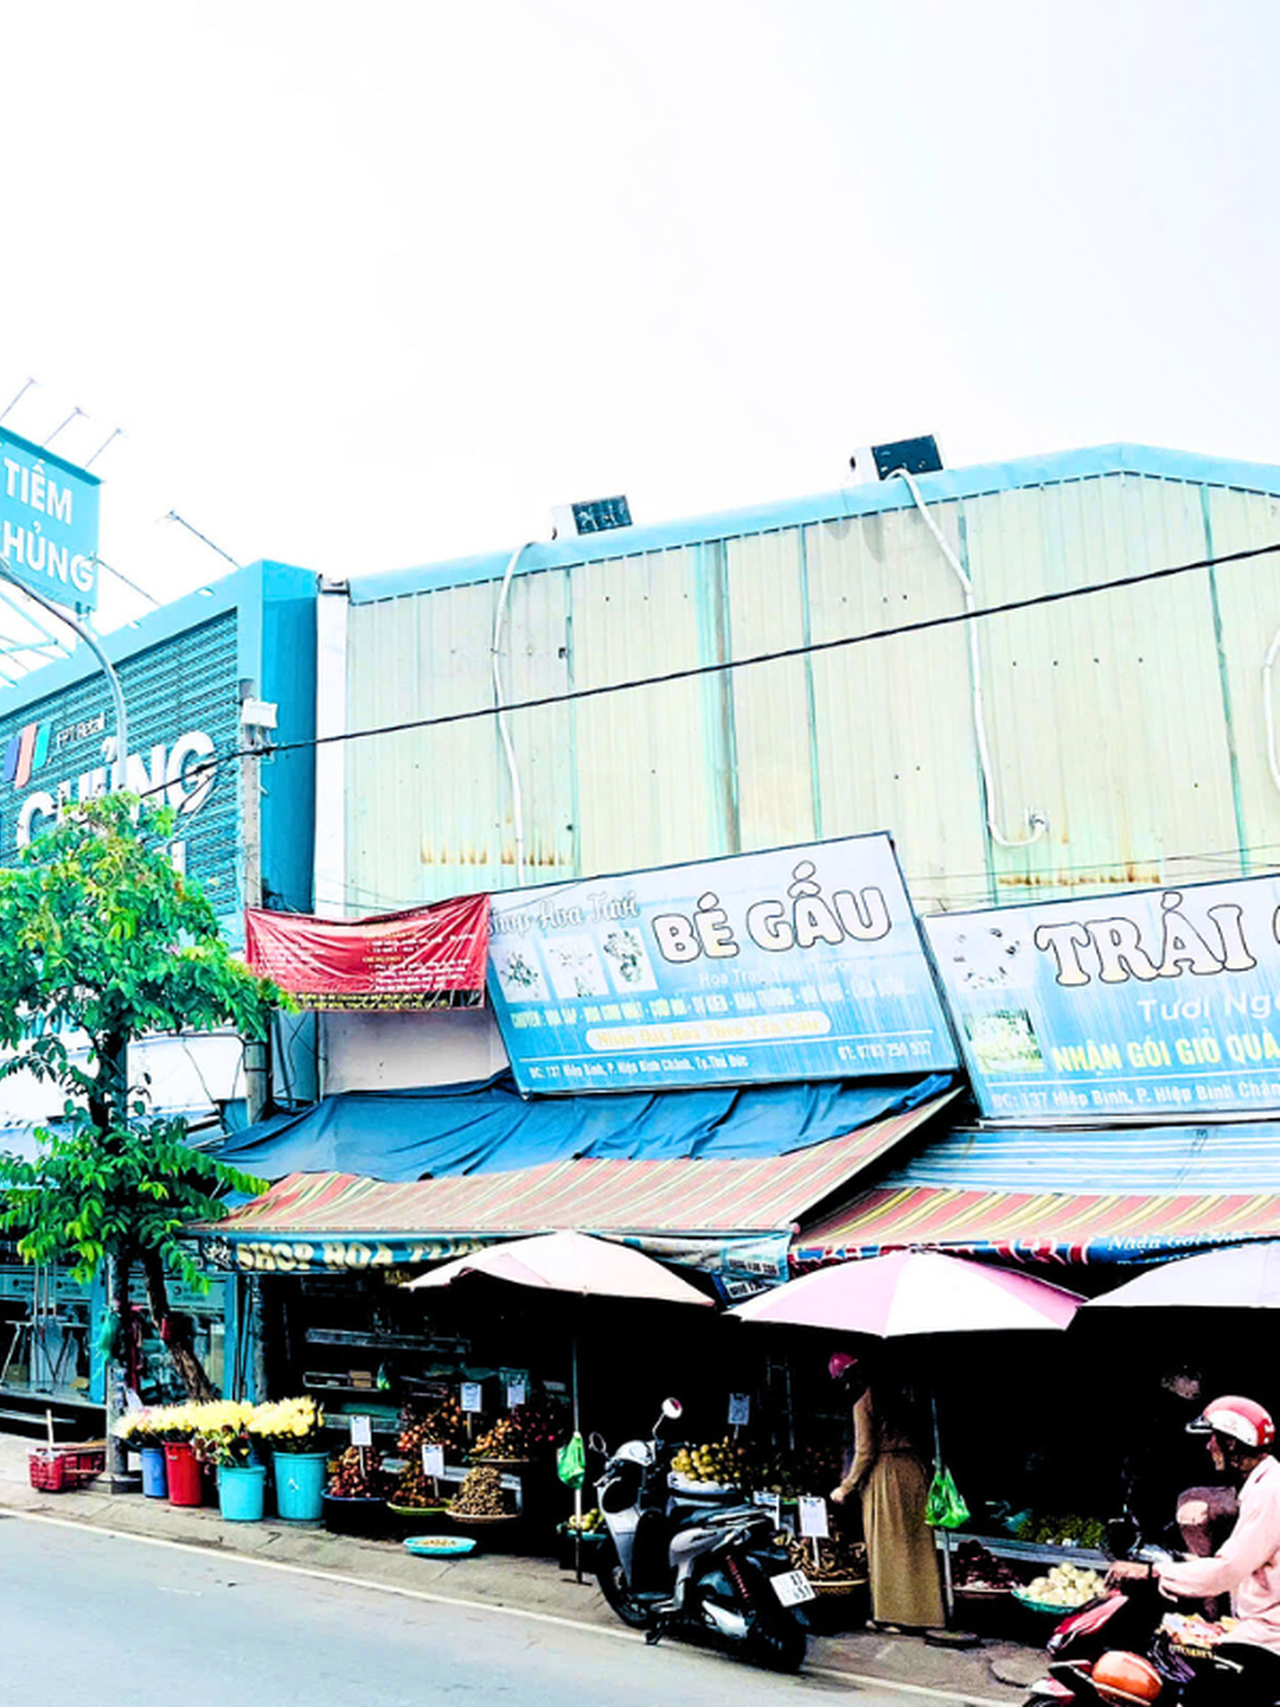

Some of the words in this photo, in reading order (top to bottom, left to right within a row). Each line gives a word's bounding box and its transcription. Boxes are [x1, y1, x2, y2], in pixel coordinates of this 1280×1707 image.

[4, 457, 72, 525] TIÊM
[652, 892, 740, 964] BÉ
[746, 860, 892, 952] GẤU
[1034, 891, 1257, 986] TRÁI
[1137, 995, 1210, 1022] Tươi
[1051, 1037, 1123, 1075] NHẬN
[1127, 1035, 1172, 1068] GÓI
[1175, 1028, 1220, 1066] GIỎ
[1226, 1021, 1280, 1064] QUÀ
[1052, 1089, 1089, 1108] Hiệp
[1136, 1087, 1152, 1103] P.
[1154, 1085, 1192, 1106] Hiệp
[236, 1242, 314, 1271] SHOP
[322, 1241, 395, 1270] HOA
